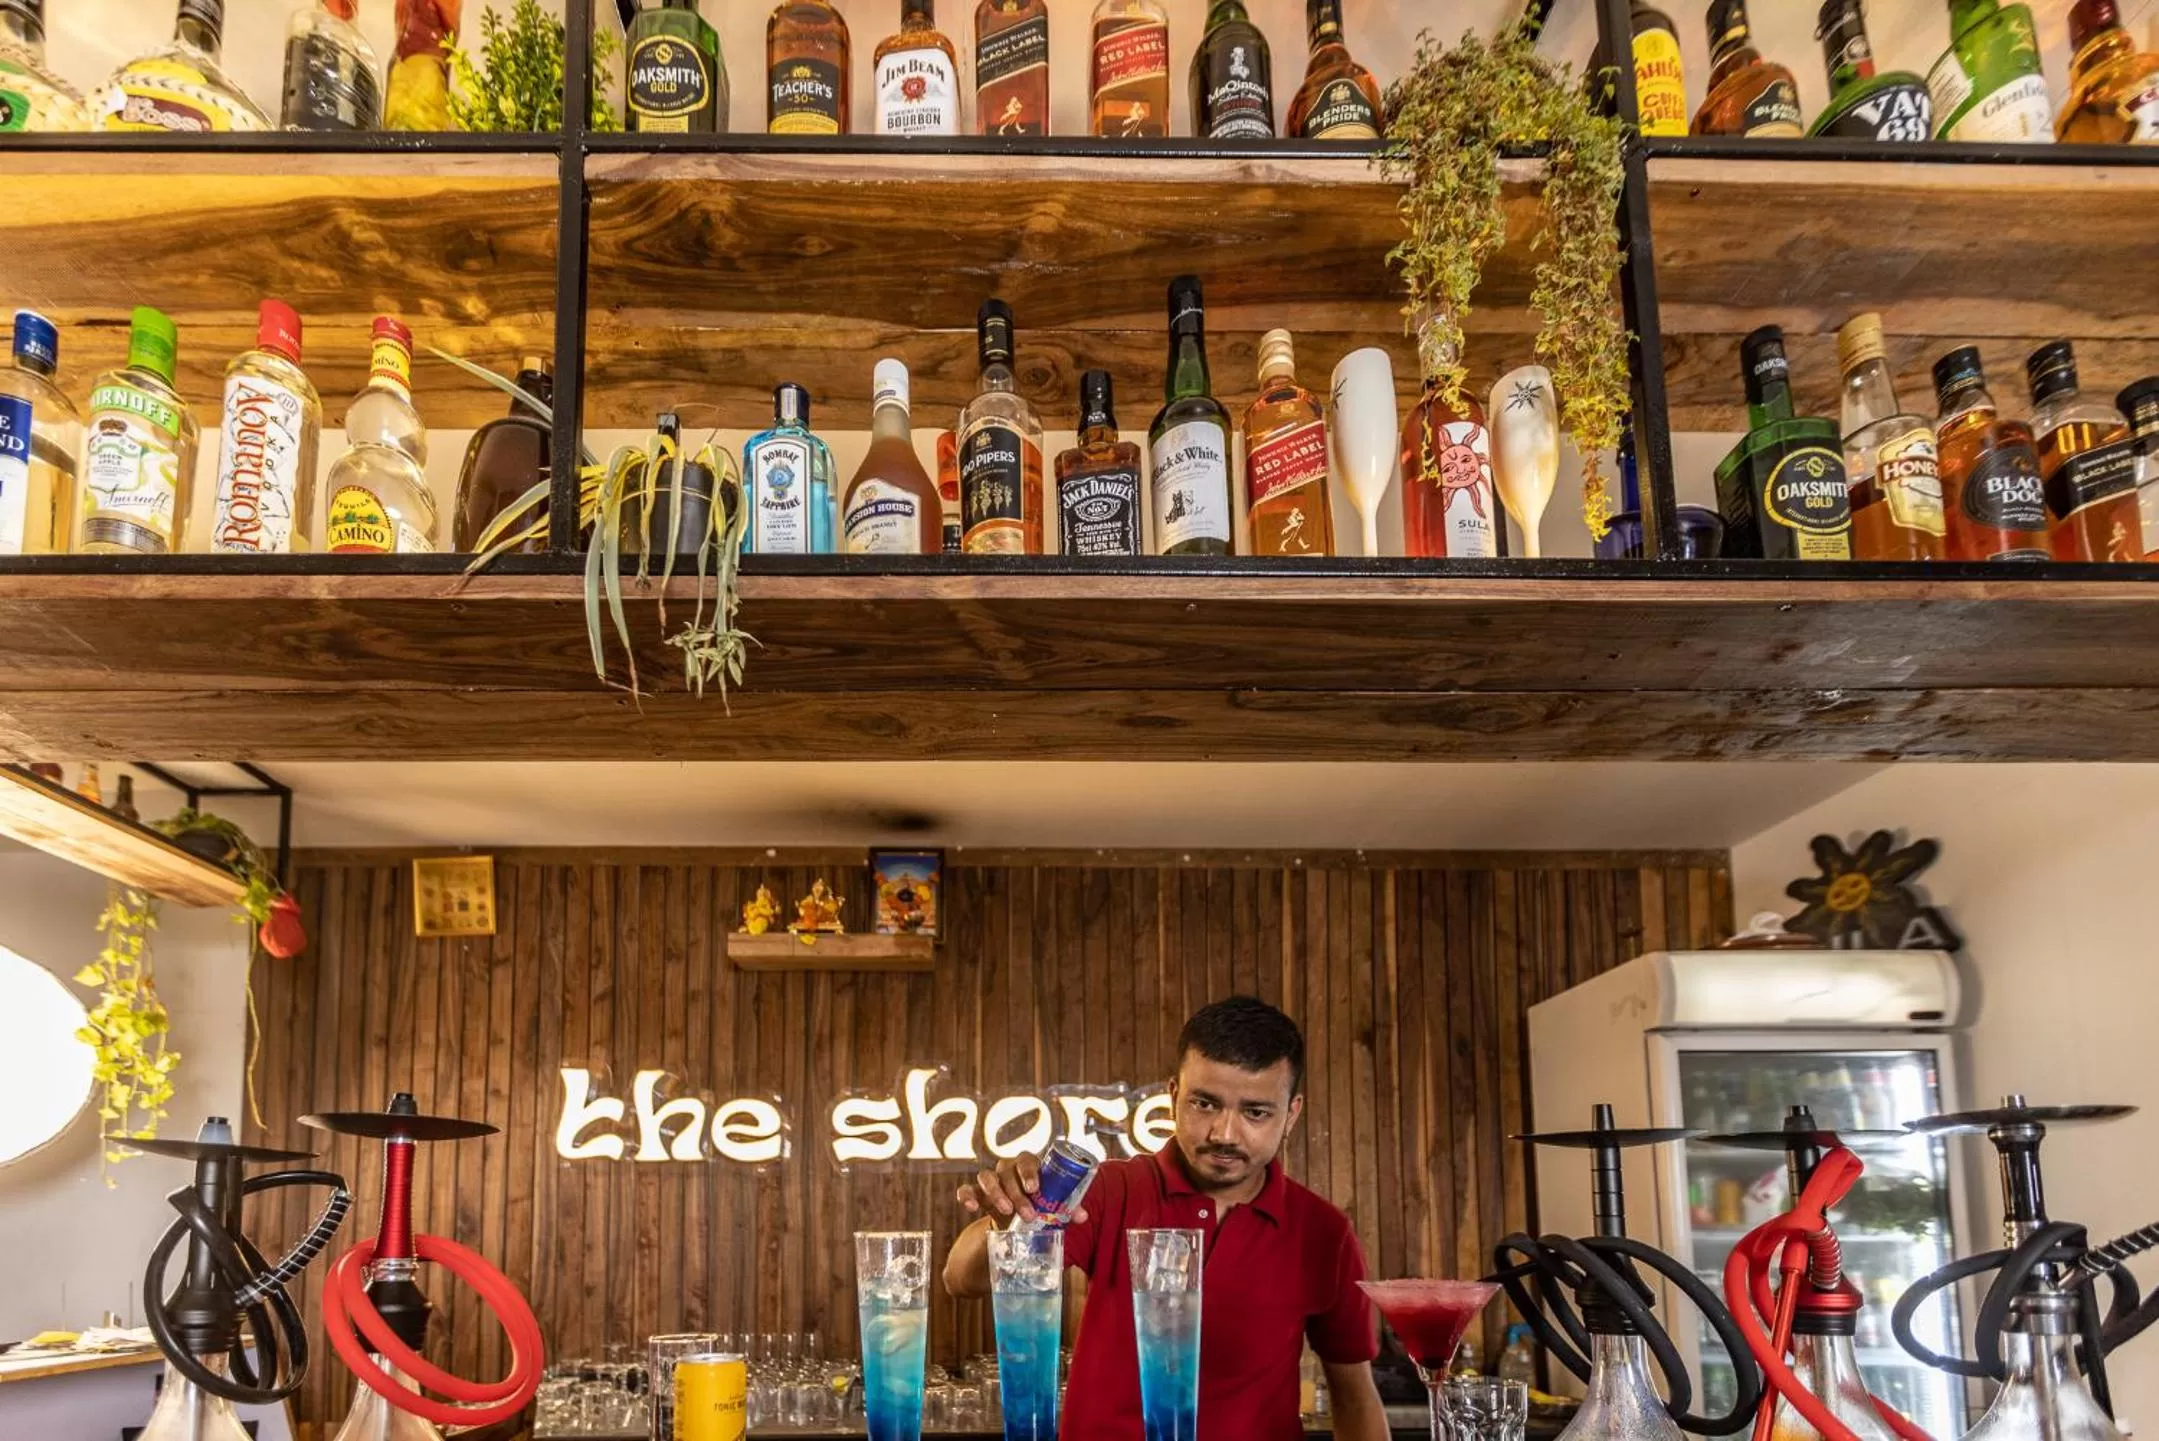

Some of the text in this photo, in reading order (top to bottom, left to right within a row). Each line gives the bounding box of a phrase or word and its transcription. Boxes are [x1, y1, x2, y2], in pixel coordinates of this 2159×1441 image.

[1011, 35, 1045, 51] LABEL
[1100, 50, 1124, 65] RED
[1127, 40, 1165, 56] LABEL
[632, 67, 700, 88] OAKSMITH
[882, 59, 945, 88] JIM BEAM
[650, 81, 677, 93] GOLD
[773, 81, 833, 102] TEACHER'S
[887, 113, 941, 129] BOURBON
[1322, 112, 1361, 128] PRIDE
[763, 449, 800, 465] BOMBAY
[976, 450, 1016, 467] PIPERS
[1183, 446, 1221, 462] White
[1255, 459, 1281, 476] RED
[1283, 441, 1325, 462] LABEL
[1062, 479, 1135, 509] JACK DANIEL'S
[760, 495, 802, 511] SAPPHIRE
[877, 501, 915, 514] HOUSE
[1805, 496, 1833, 509] GOLD
[1076, 532, 1122, 545] WHISKEY
[557, 1067, 782, 1162] the
